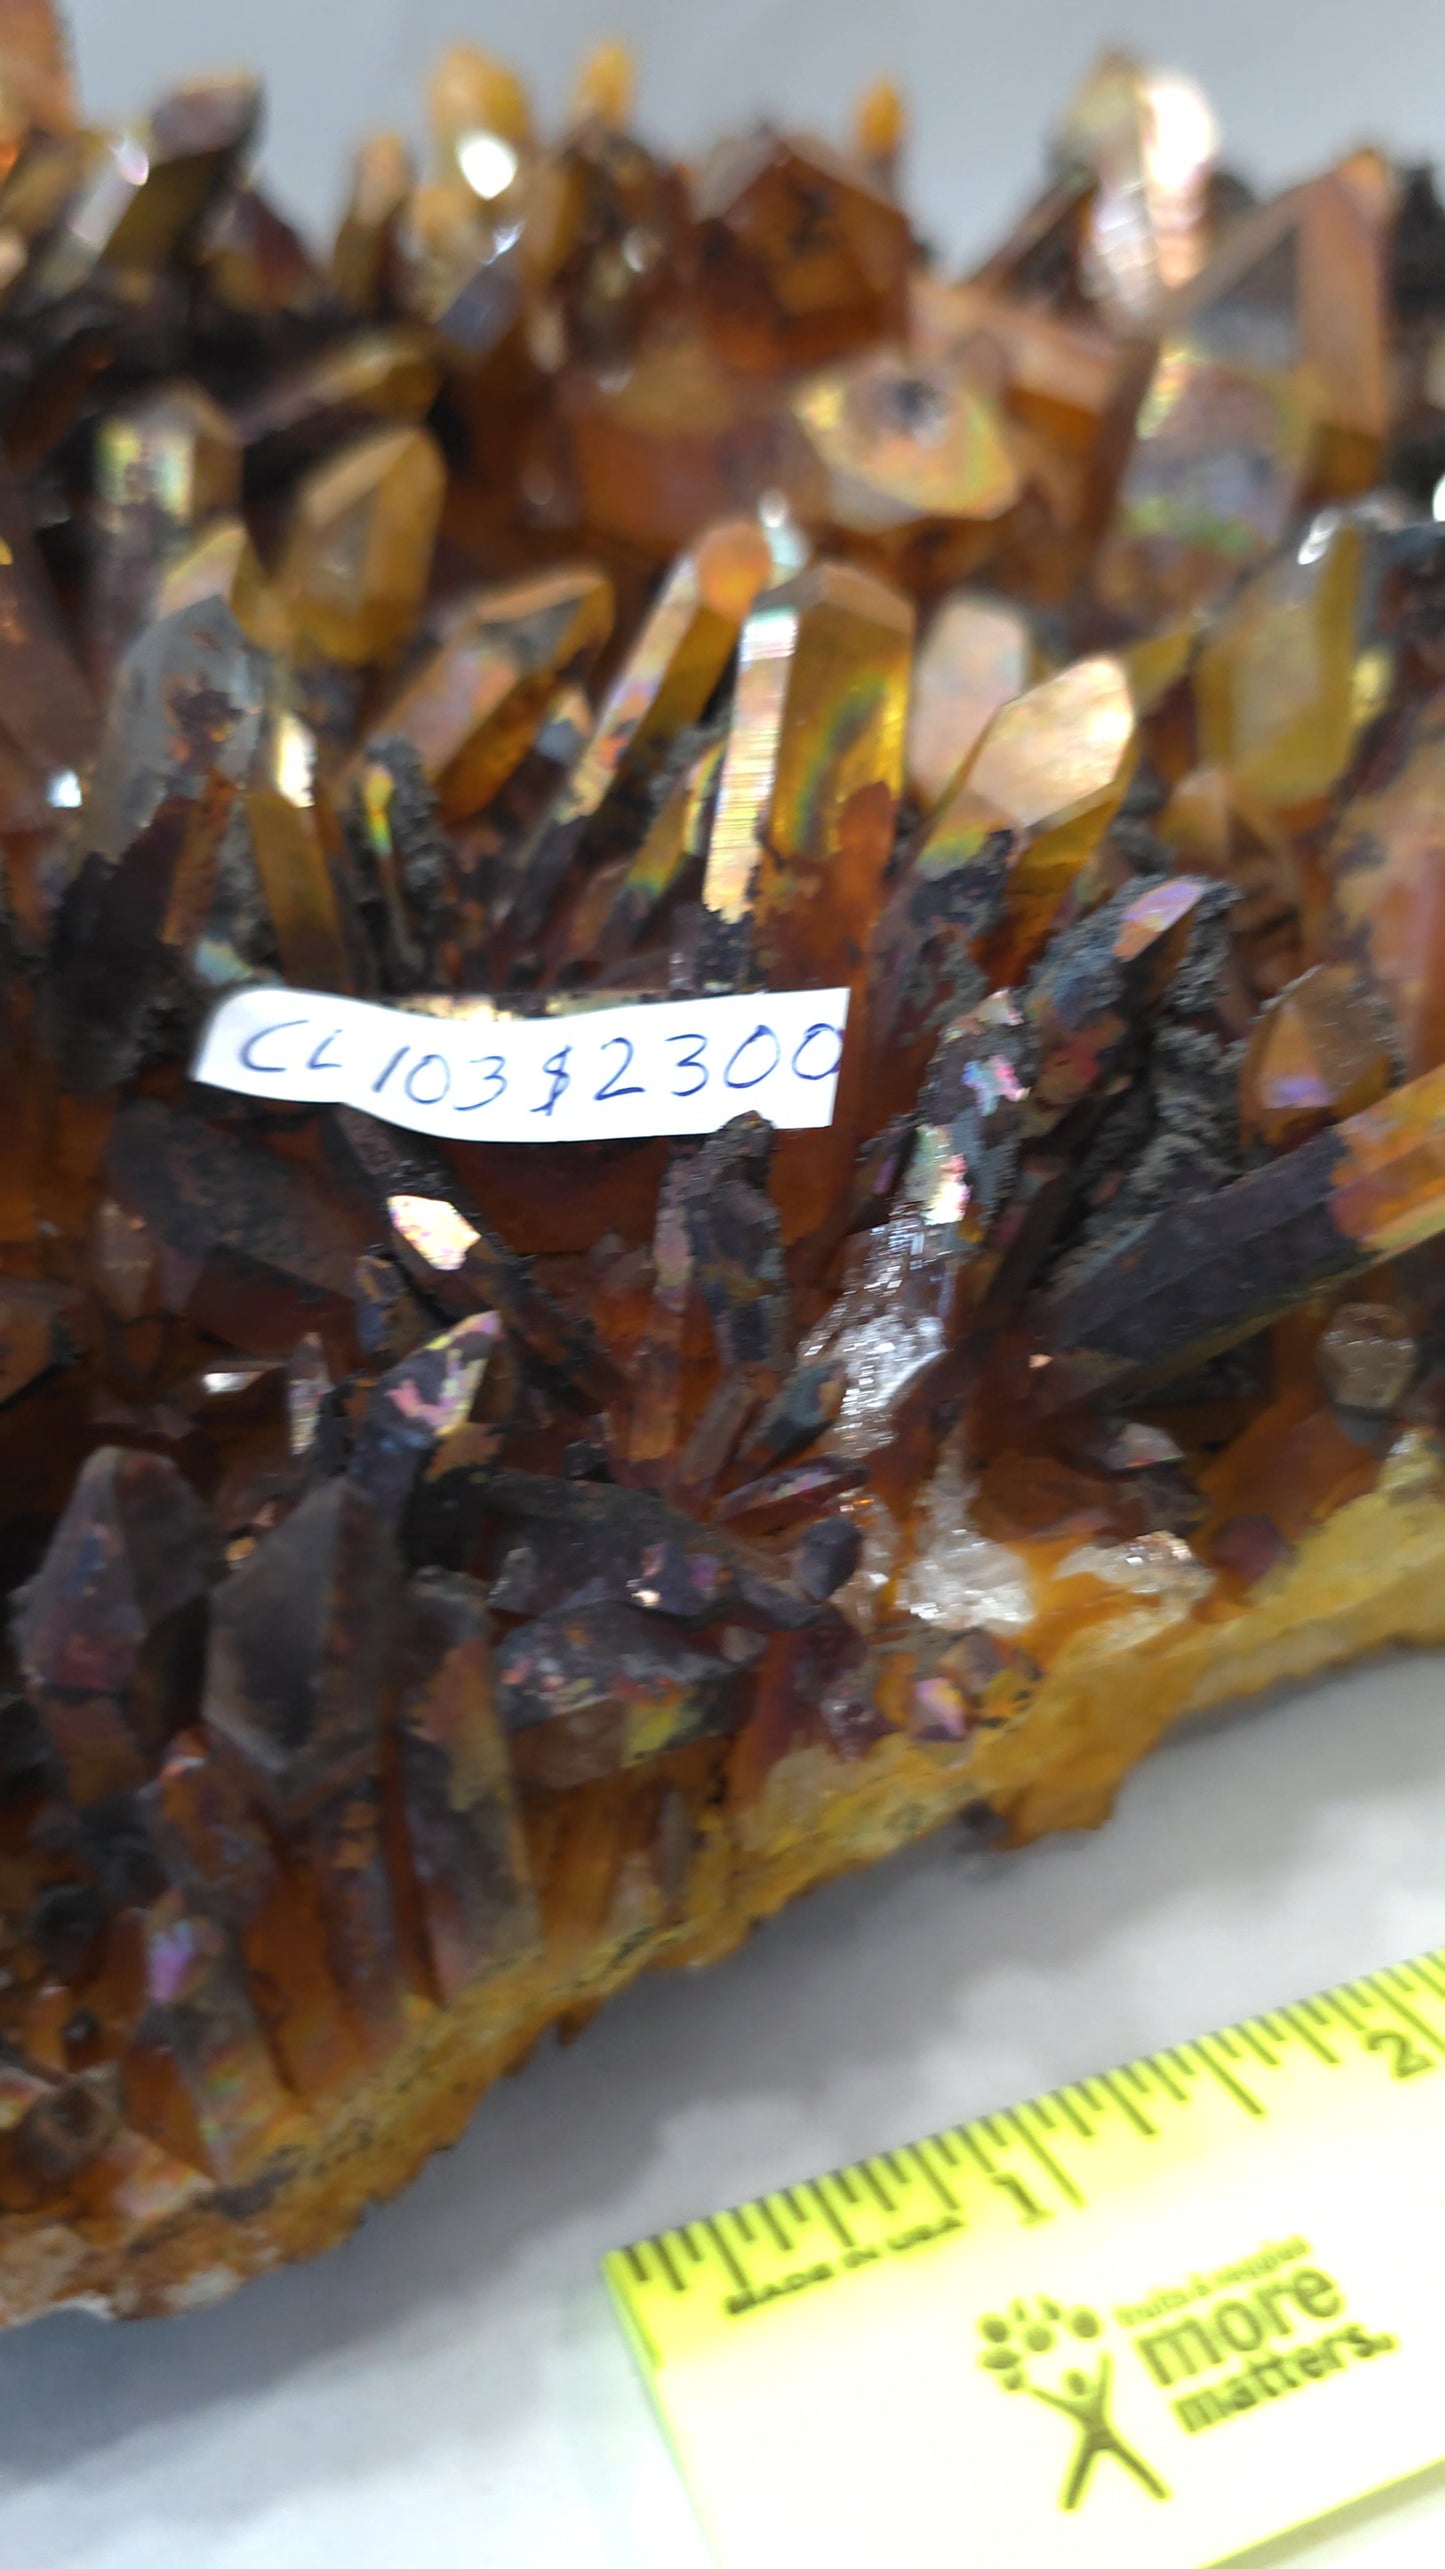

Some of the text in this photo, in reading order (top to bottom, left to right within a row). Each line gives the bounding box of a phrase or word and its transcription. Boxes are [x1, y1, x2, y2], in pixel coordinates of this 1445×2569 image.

[239, 1019, 844, 1117] CL 103 $2300
[1365, 2029, 1434, 2079] 2
[990, 2172, 1055, 2227] 1
[1135, 2268, 1343, 2388] more
